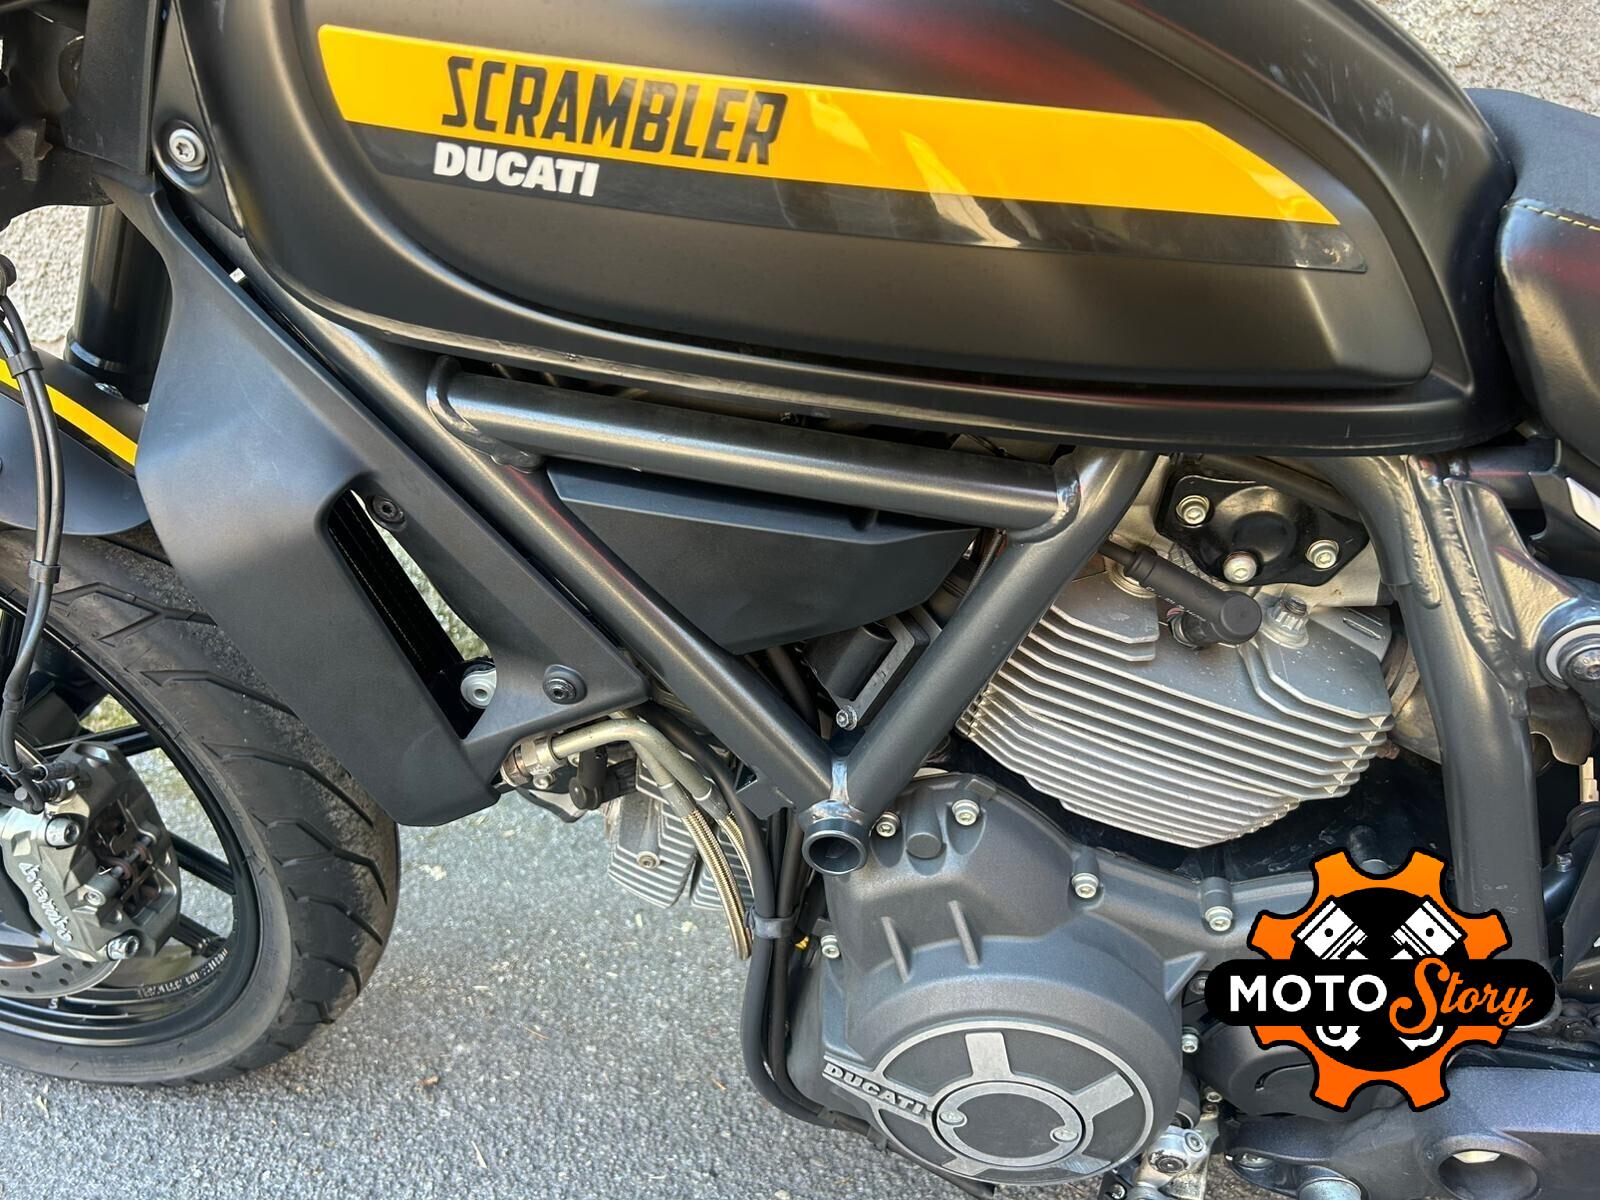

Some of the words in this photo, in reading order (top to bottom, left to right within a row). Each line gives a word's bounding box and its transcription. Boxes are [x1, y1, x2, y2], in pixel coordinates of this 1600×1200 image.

[441, 55, 789, 166] SCRAMBLER
[433, 141, 600, 198] DUCATI
[823, 1062, 924, 1115] DUCATI
